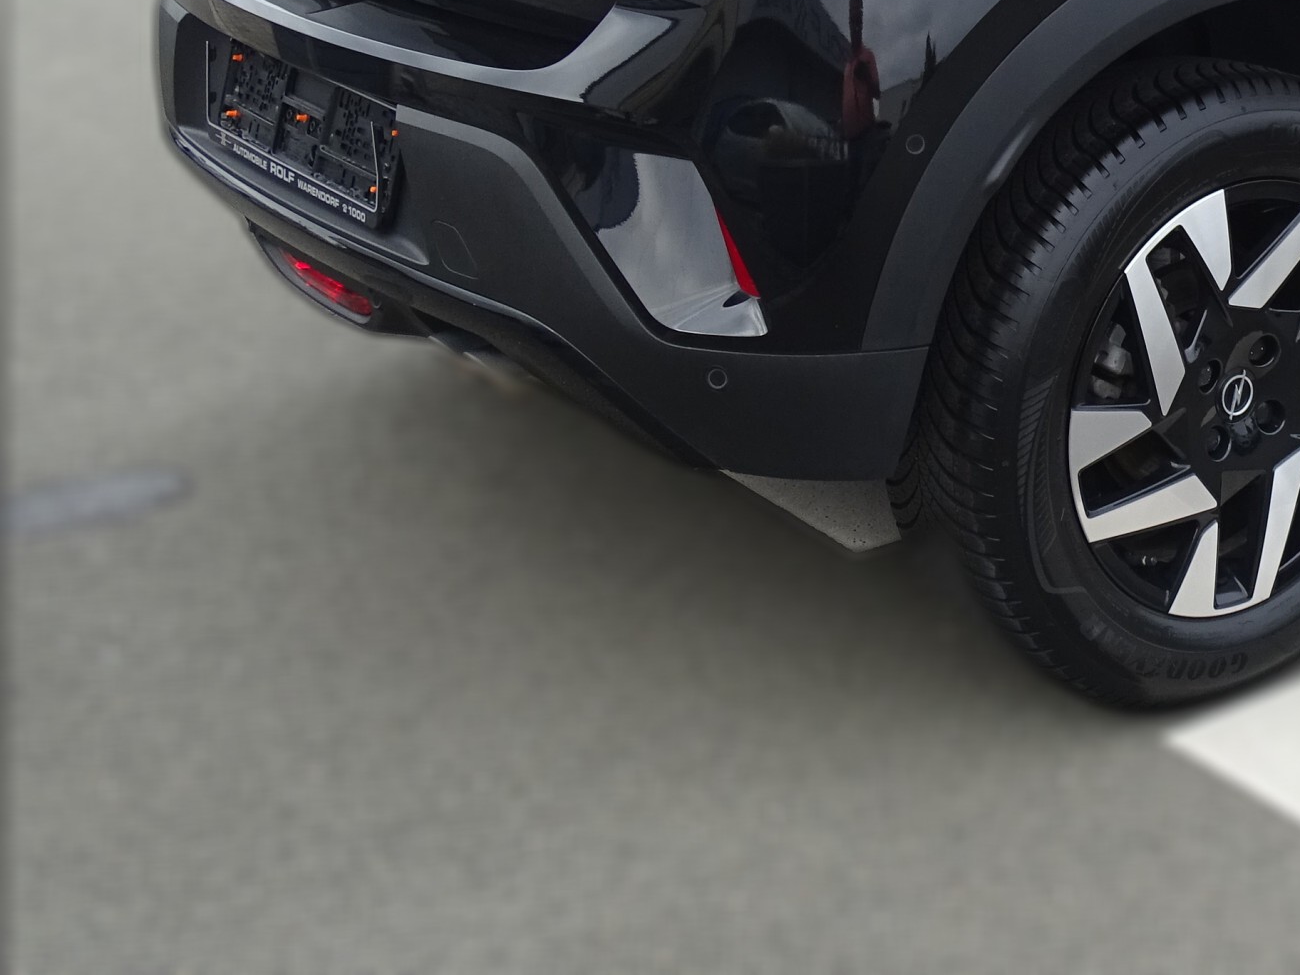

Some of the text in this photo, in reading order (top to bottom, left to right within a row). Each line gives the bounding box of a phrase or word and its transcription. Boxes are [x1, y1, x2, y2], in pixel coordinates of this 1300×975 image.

[233, 143, 268, 170] AUTOMOBILE
[270, 161, 295, 183] ROLF
[297, 178, 340, 208] WARENDORF
